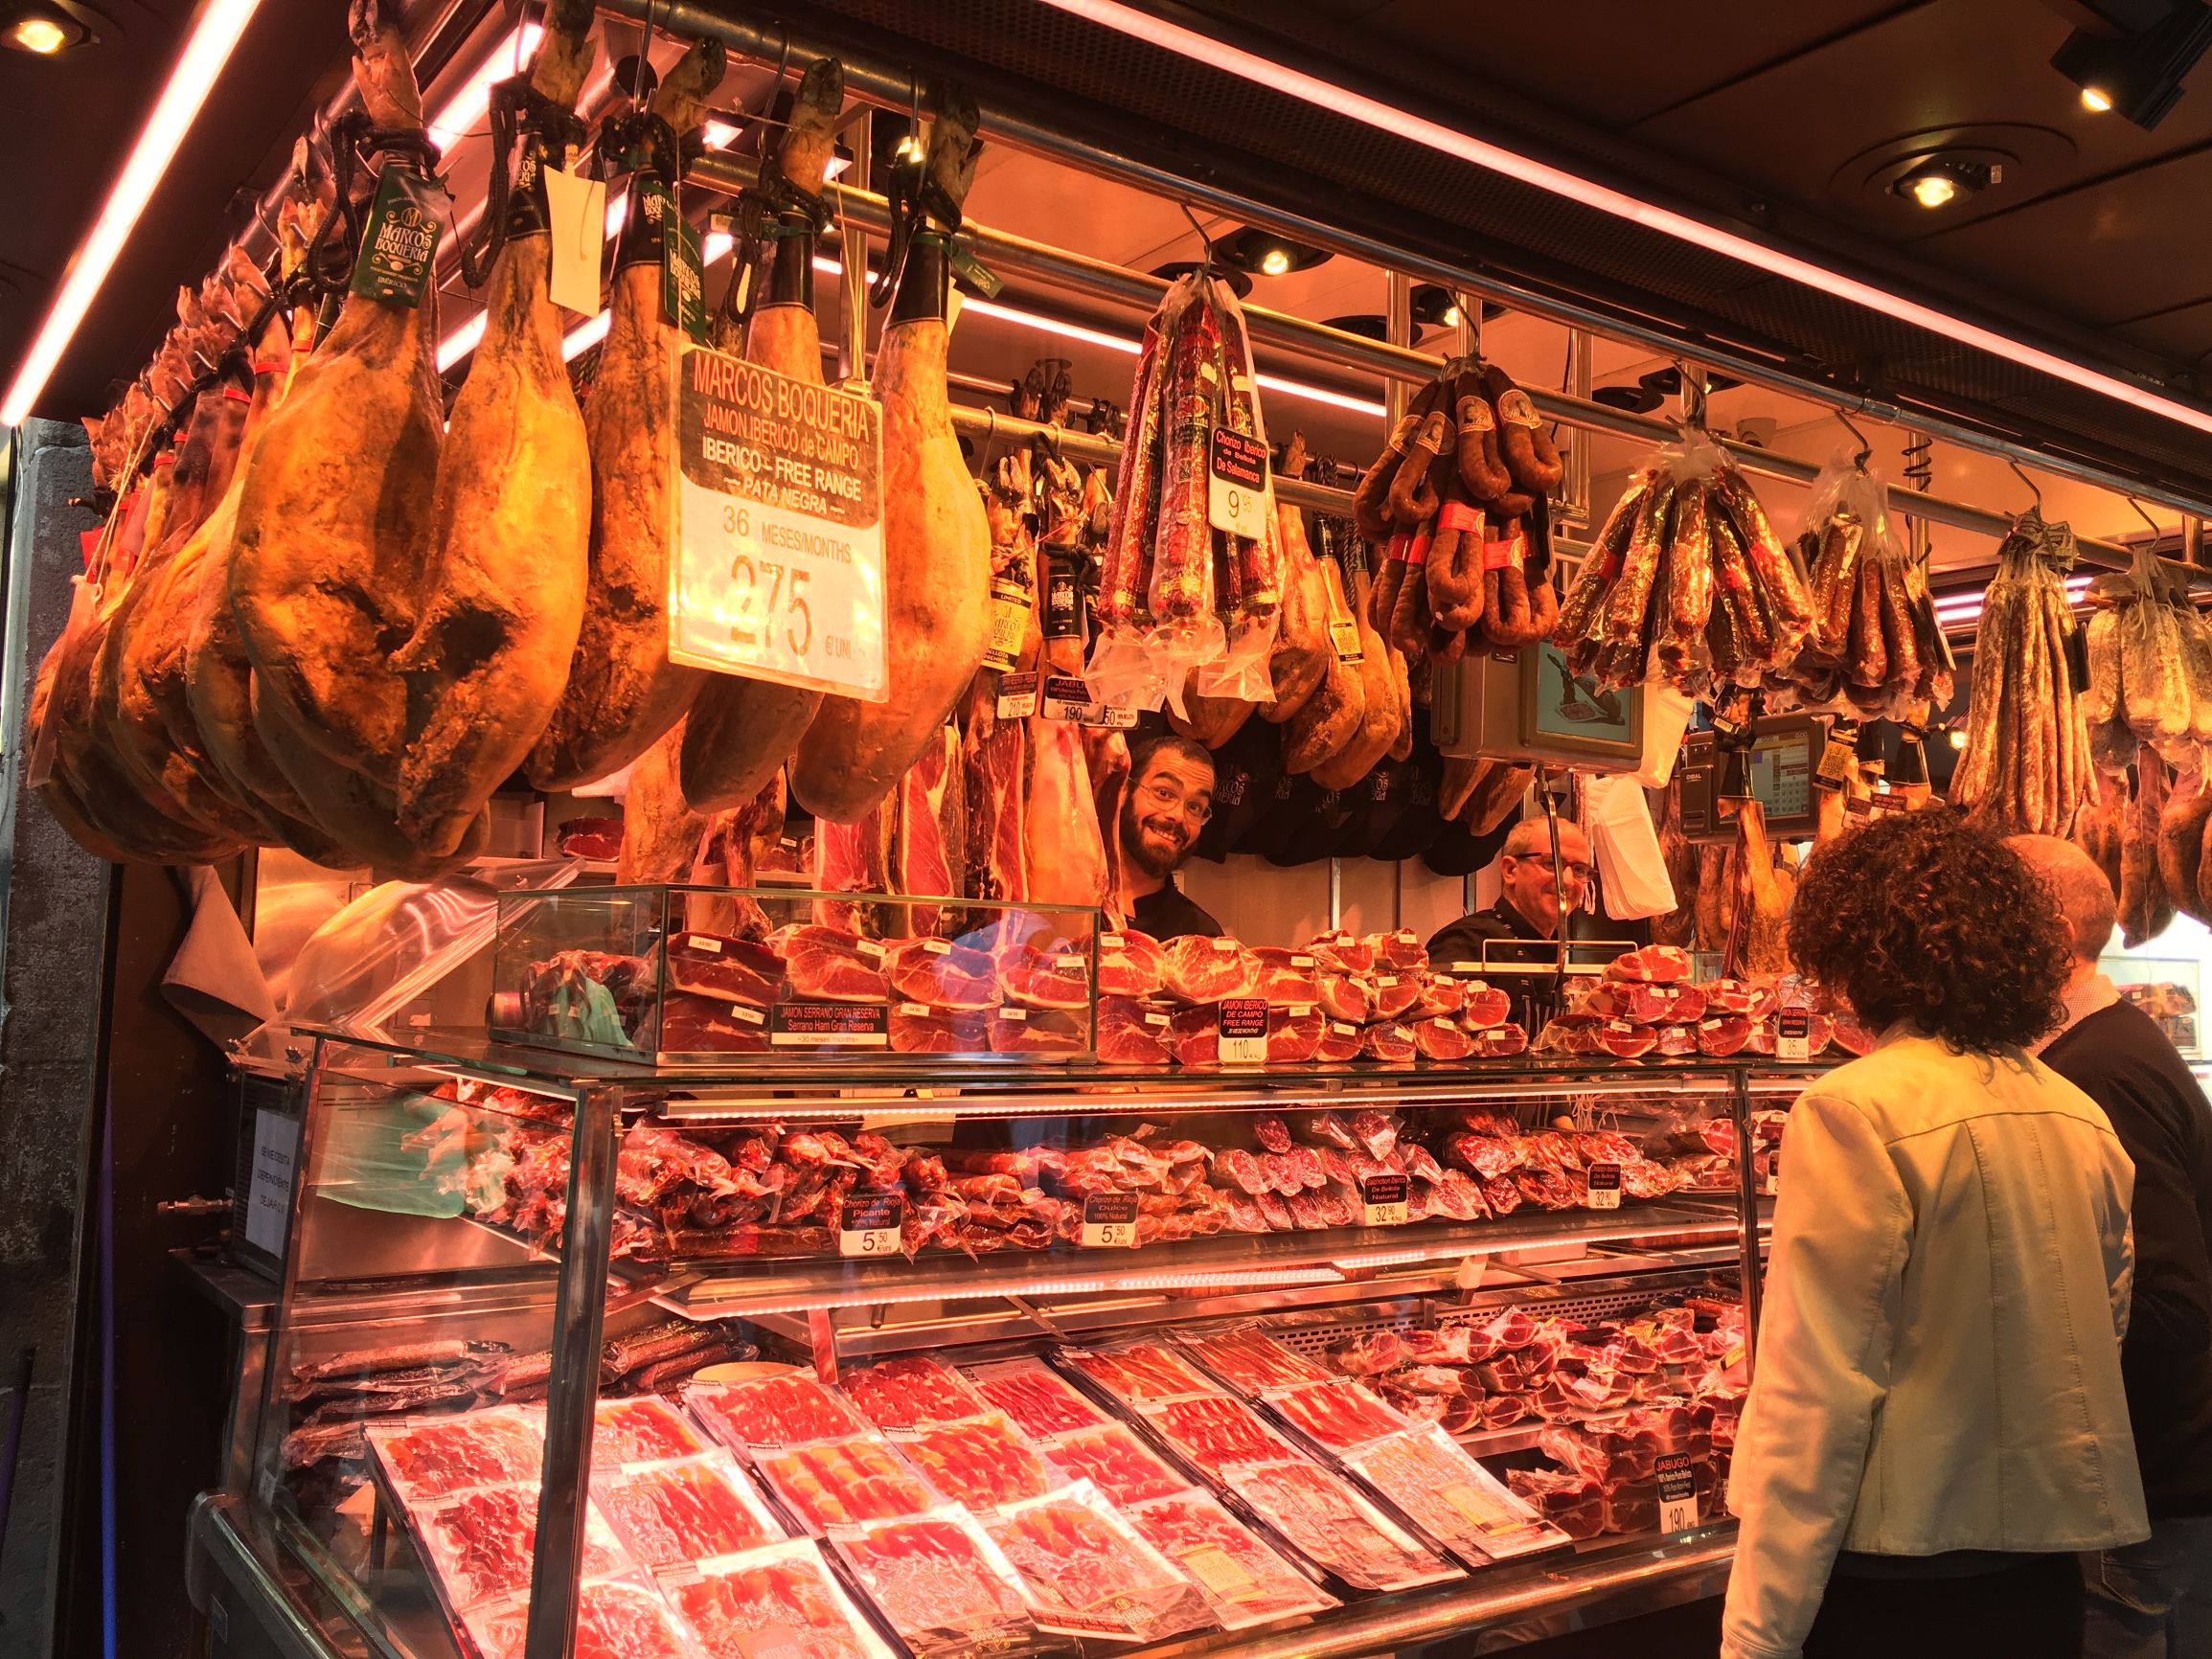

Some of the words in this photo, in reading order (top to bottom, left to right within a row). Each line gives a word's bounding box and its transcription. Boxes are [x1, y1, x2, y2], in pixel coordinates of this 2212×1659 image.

[379, 222, 433, 249] MARCOS
[375, 238, 429, 262] BOQUERIA
[694, 351, 773, 415] MARCOS
[778, 378, 869, 443] BOQUERIA
[801, 431, 814, 456] de
[816, 436, 858, 470] CAMPO
[1216, 430, 1242, 450] Chorizo
[1243, 440, 1266, 459] Iberico
[1234, 451, 1256, 465] Bellota
[702, 436, 762, 473] IBERICO
[775, 456, 812, 489] FREE
[815, 466, 862, 501] RANGE
[1217, 456, 1226, 471] De
[1226, 460, 1260, 484] Salamanca
[743, 476, 778, 502] PATA
[781, 487, 827, 515] NEGRA
[1228, 489, 1240, 518] 9
[723, 505, 750, 537] 36
[762, 521, 852, 564] MESES/MONTHS
[730, 554, 812, 656] 275
[1000, 594, 1022, 604] LIMITED
[1056, 679, 1084, 689] JABU
[1064, 706, 1083, 721] 190
[781, 1006, 803, 1018] JAMON
[805, 1007, 833, 1018] SERRANO
[834, 1008, 853, 1019] GRAN
[854, 1008, 880, 1019] RESERVA
[1222, 1001, 1243, 1010] JAMON
[1244, 1001, 1267, 1010] IBERICO
[787, 1019, 813, 1031] Serrano
[814, 1020, 830, 1031] Ham
[832, 1020, 847, 1031] Gran
[849, 1020, 874, 1032] Reserva
[1233, 1039, 1249, 1059] 110
[844, 1199, 870, 1208] Chorizo
[883, 1197, 901, 1208] Rioja
[1596, 1192, 1604, 1206] 32
[853, 1209, 890, 1217] Picante
[1376, 1205, 1386, 1222] 32
[862, 1232, 875, 1251] 5
[1102, 1225, 1112, 1243] 5
[1657, 1457, 1689, 1471] JABUGO
[1670, 1507, 1685, 1533] 190
